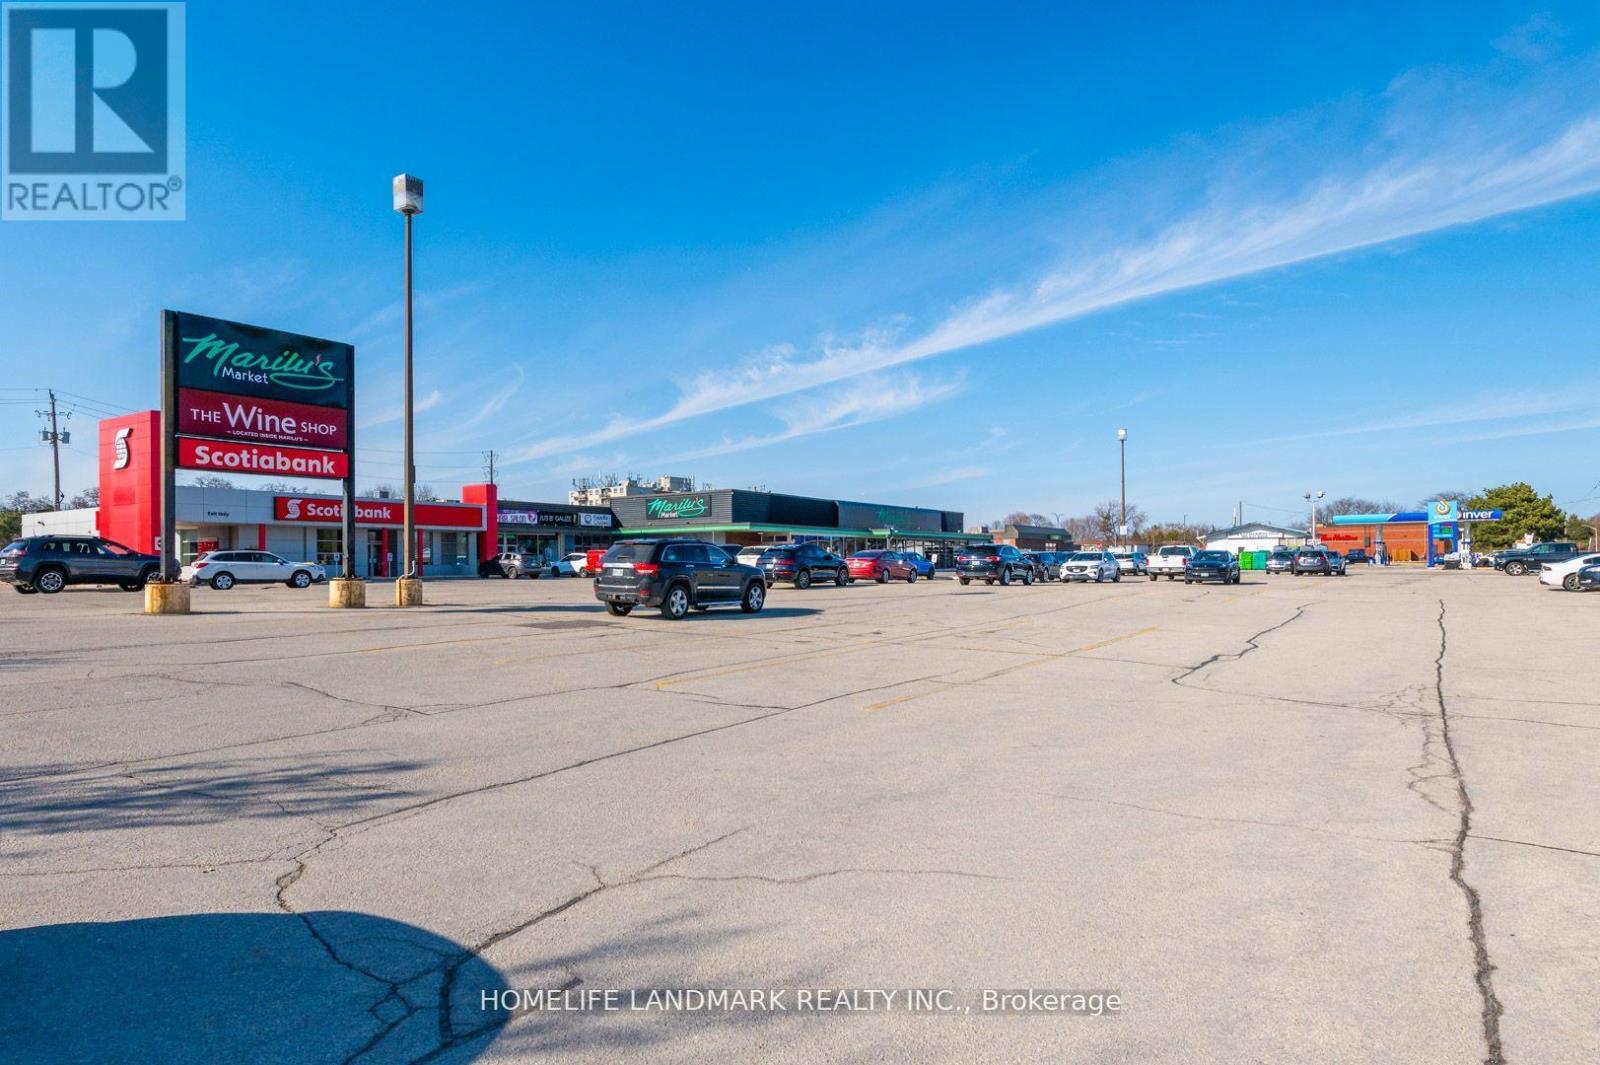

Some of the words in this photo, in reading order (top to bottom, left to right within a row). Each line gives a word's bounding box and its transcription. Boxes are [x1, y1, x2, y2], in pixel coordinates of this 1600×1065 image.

[182, 333, 344, 390] Marilu's
[221, 366, 269, 384] Market
[190, 408, 221, 423] THE
[222, 402, 297, 434] Wine
[300, 421, 337, 435] SHOP
[195, 445, 336, 474] Scotiabank
[306, 503, 391, 519] Scotibank
[648, 496, 708, 518] Marilu's
